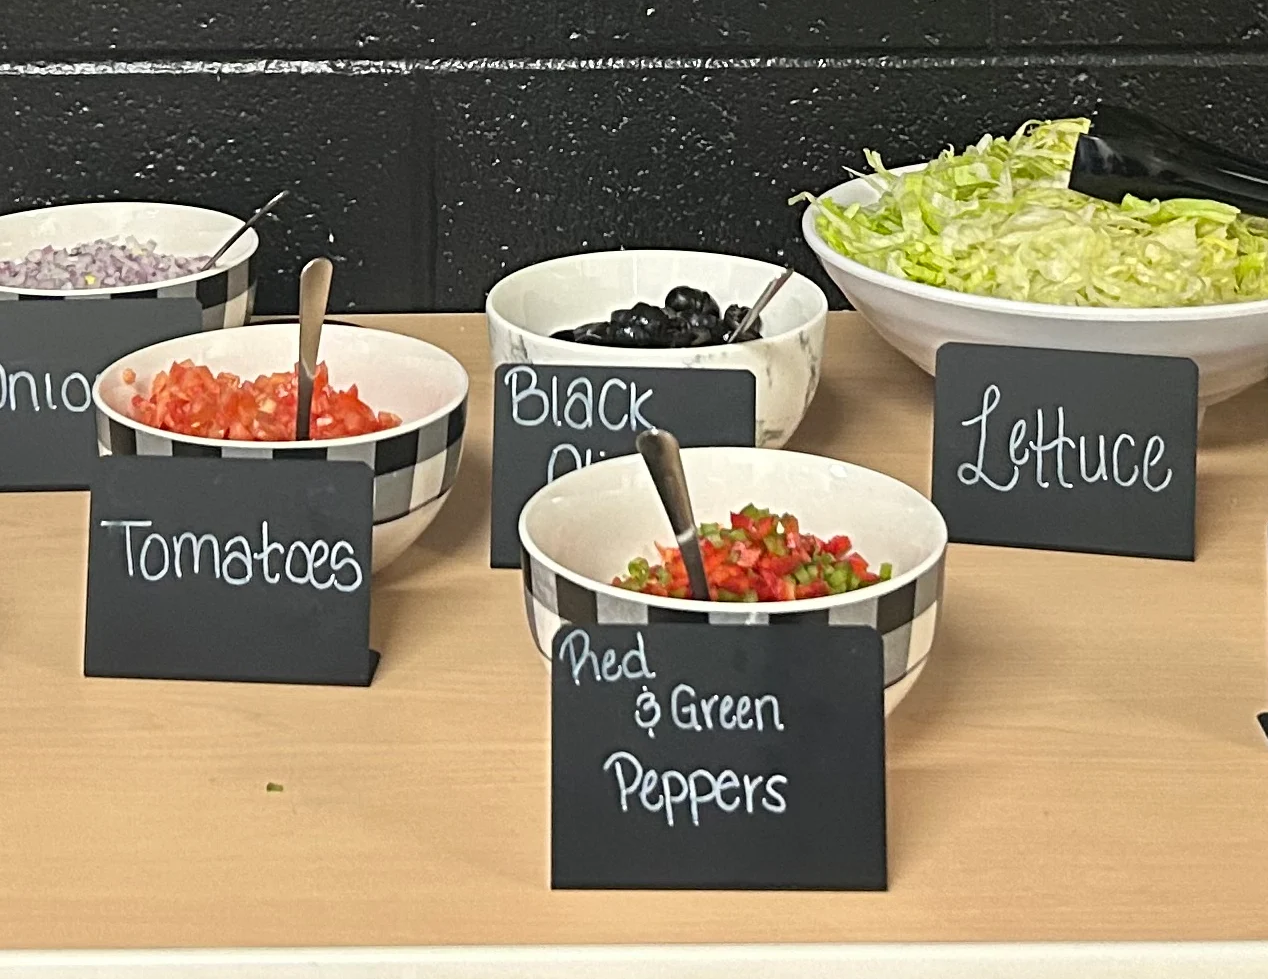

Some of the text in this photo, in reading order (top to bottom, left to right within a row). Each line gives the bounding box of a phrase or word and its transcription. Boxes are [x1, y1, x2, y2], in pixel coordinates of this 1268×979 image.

[504, 365, 660, 435] Black
[957, 384, 1174, 492] Lettuce
[100, 520, 363, 592] Tomatoes
[559, 629, 656, 686] Red
[635, 684, 784, 739] & Green
[603, 751, 788, 826] Peppers
